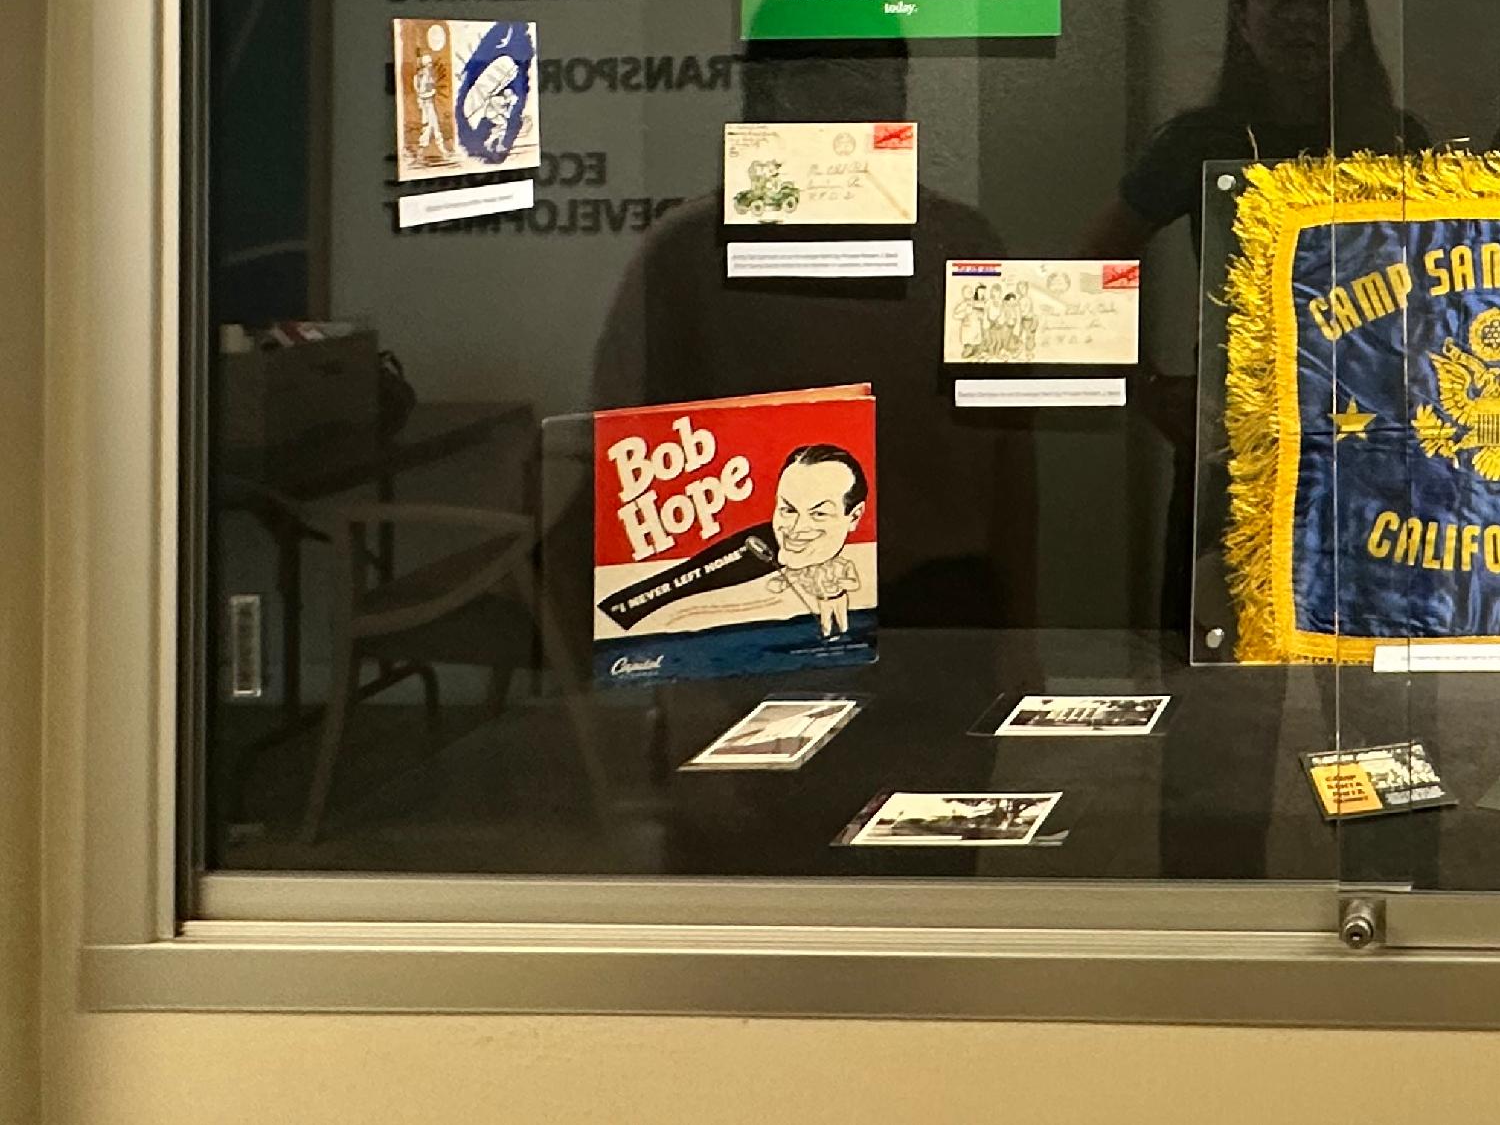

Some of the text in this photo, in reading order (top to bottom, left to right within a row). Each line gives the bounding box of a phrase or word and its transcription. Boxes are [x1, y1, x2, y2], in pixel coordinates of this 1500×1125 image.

[1309, 261, 1413, 341] CAMP
[608, 416, 716, 502] Bob
[617, 455, 753, 561] Hope
[628, 582, 672, 608] NEVER
[673, 567, 702, 588] LEFT
